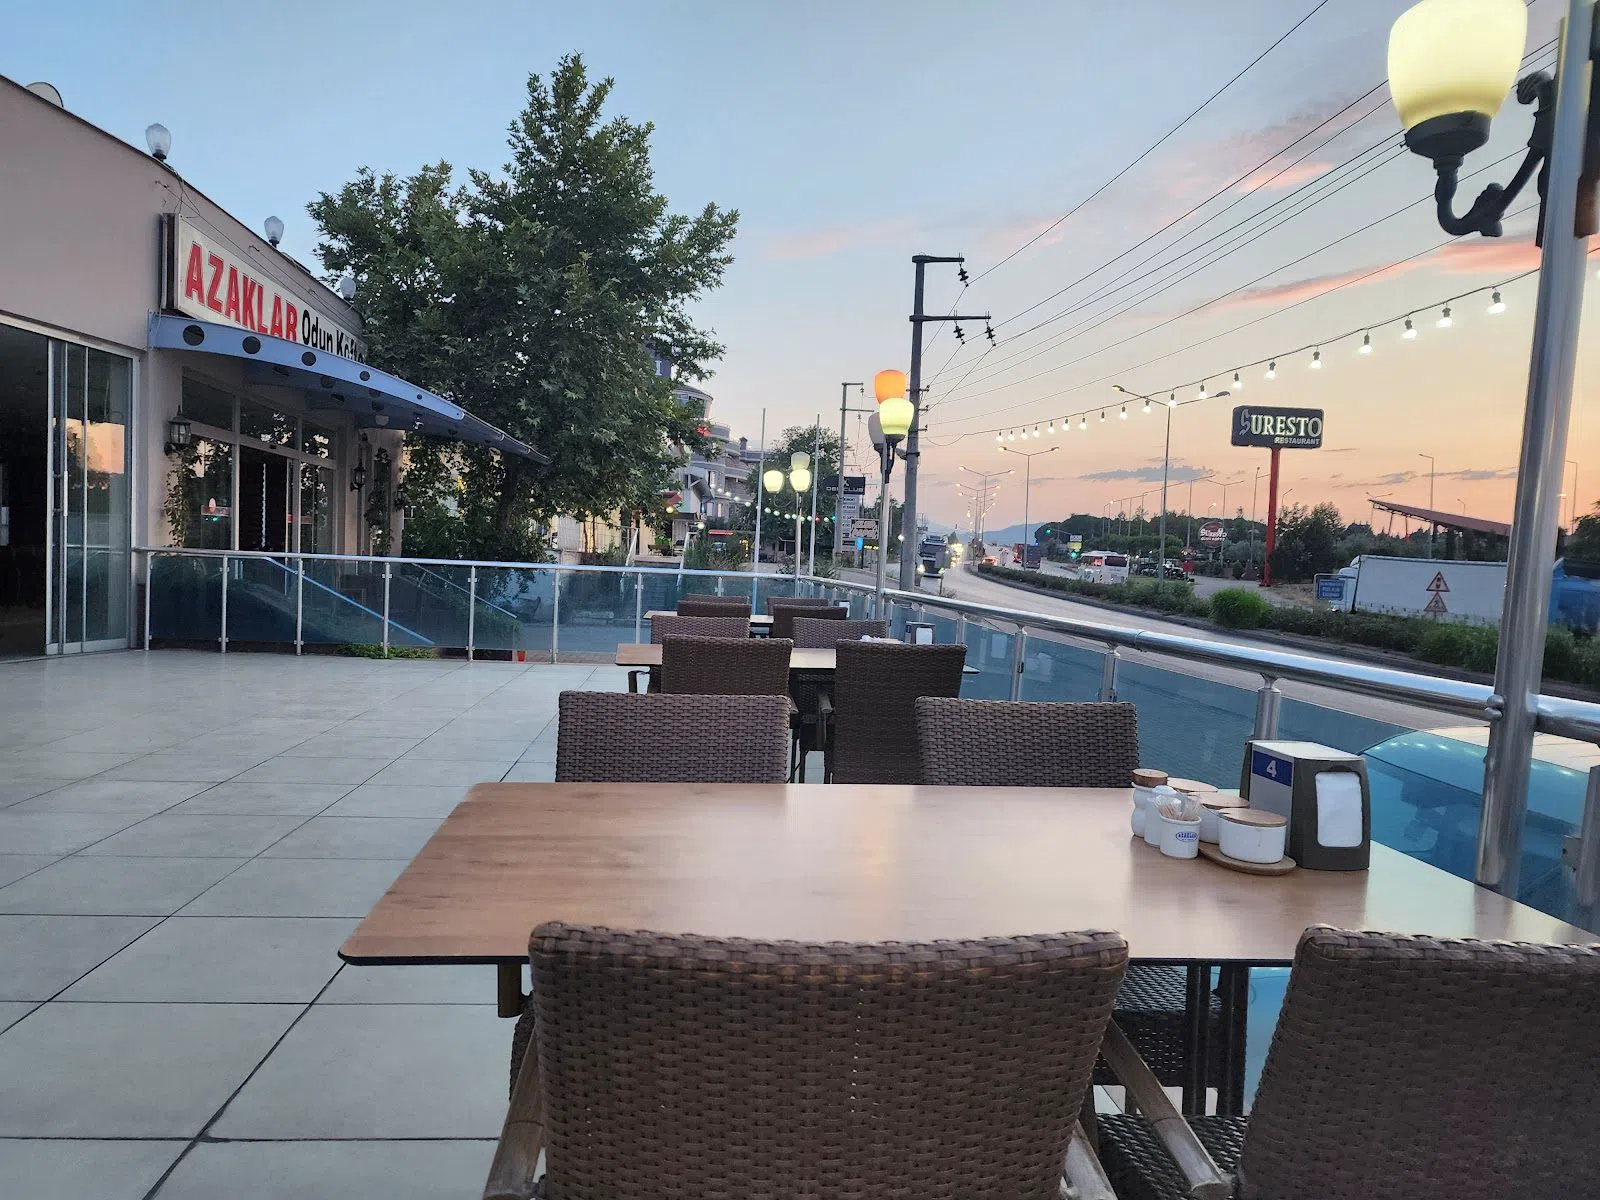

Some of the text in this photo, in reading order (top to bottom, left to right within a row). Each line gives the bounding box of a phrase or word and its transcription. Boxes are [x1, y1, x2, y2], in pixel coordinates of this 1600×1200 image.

[185, 241, 298, 342] AZAKLAR
[302, 310, 333, 353] Odun
[1239, 408, 1322, 437] SURESTO
[1274, 436, 1321, 445] RESTAURANT
[1266, 760, 1277, 778] 4
